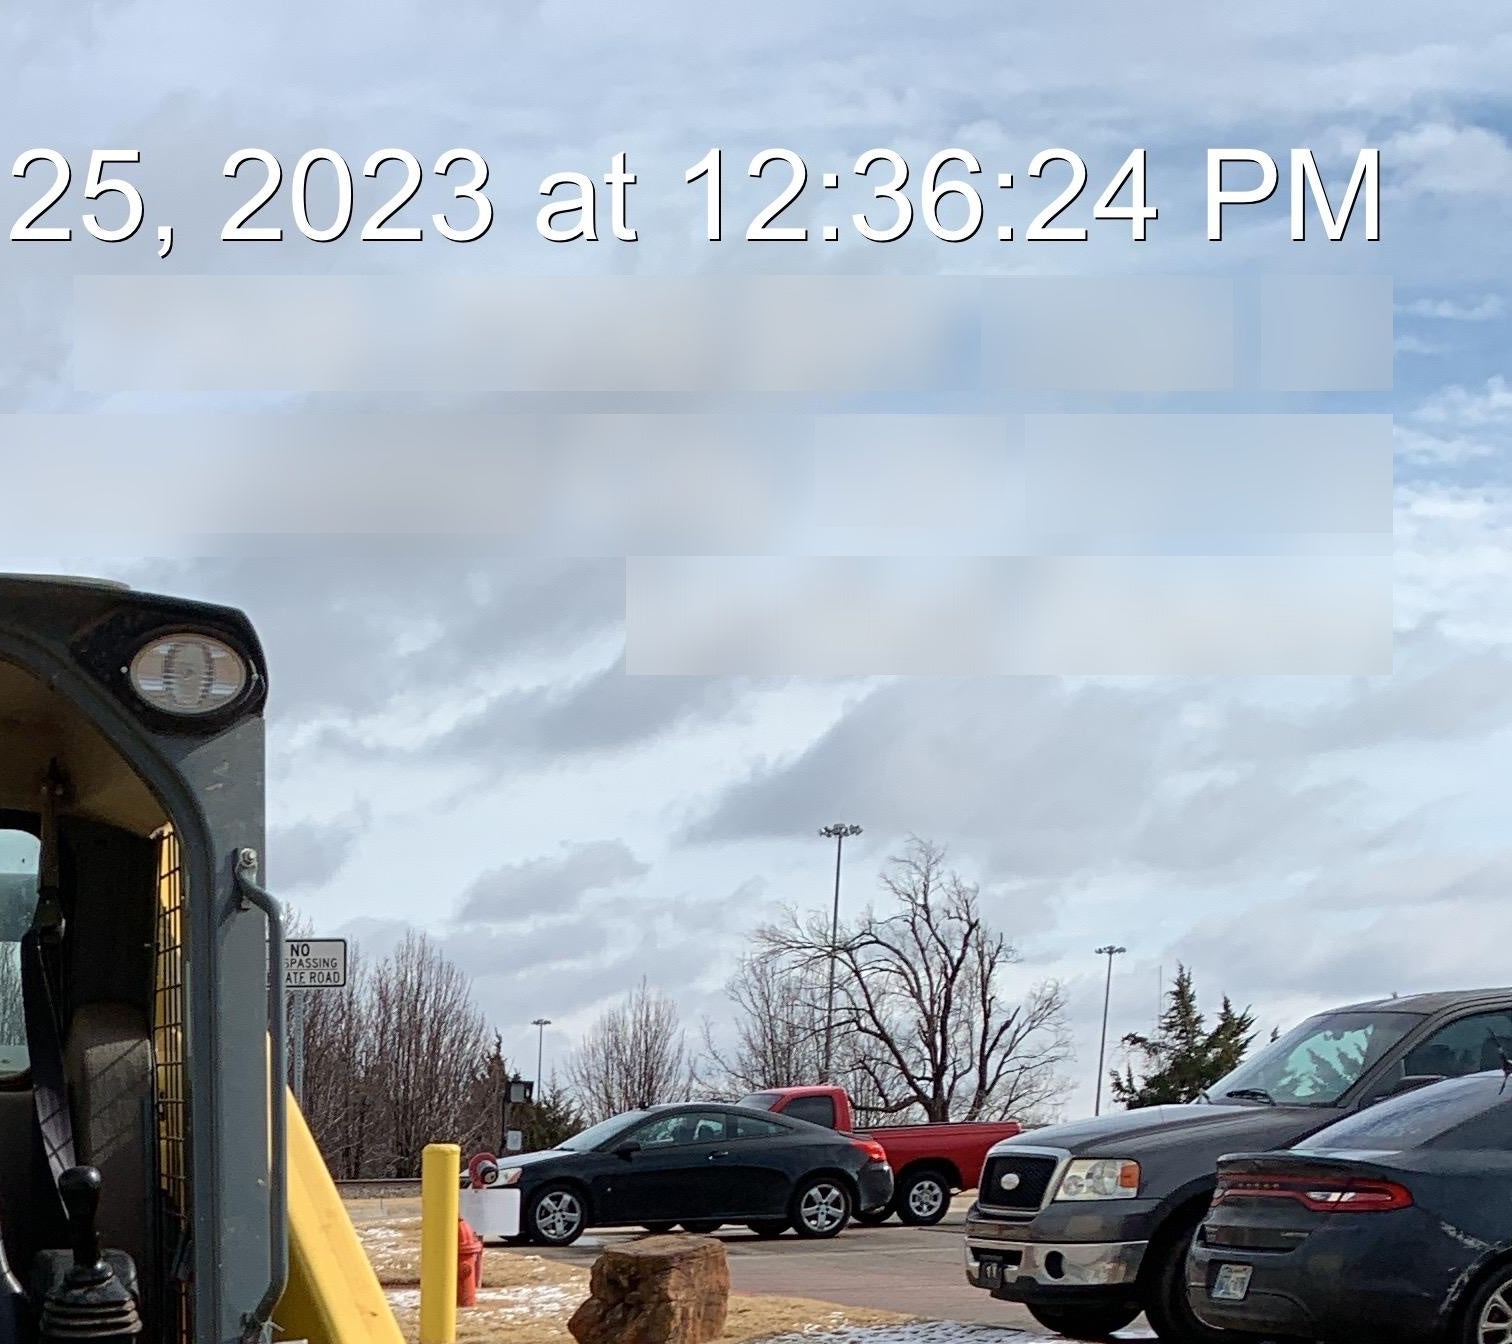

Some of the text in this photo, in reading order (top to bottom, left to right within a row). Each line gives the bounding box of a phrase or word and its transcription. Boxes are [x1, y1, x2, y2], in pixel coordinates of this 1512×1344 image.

[290, 943, 310, 957] NO
[284, 958, 338, 969] SPASSING
[309, 971, 340, 984] ROAD
